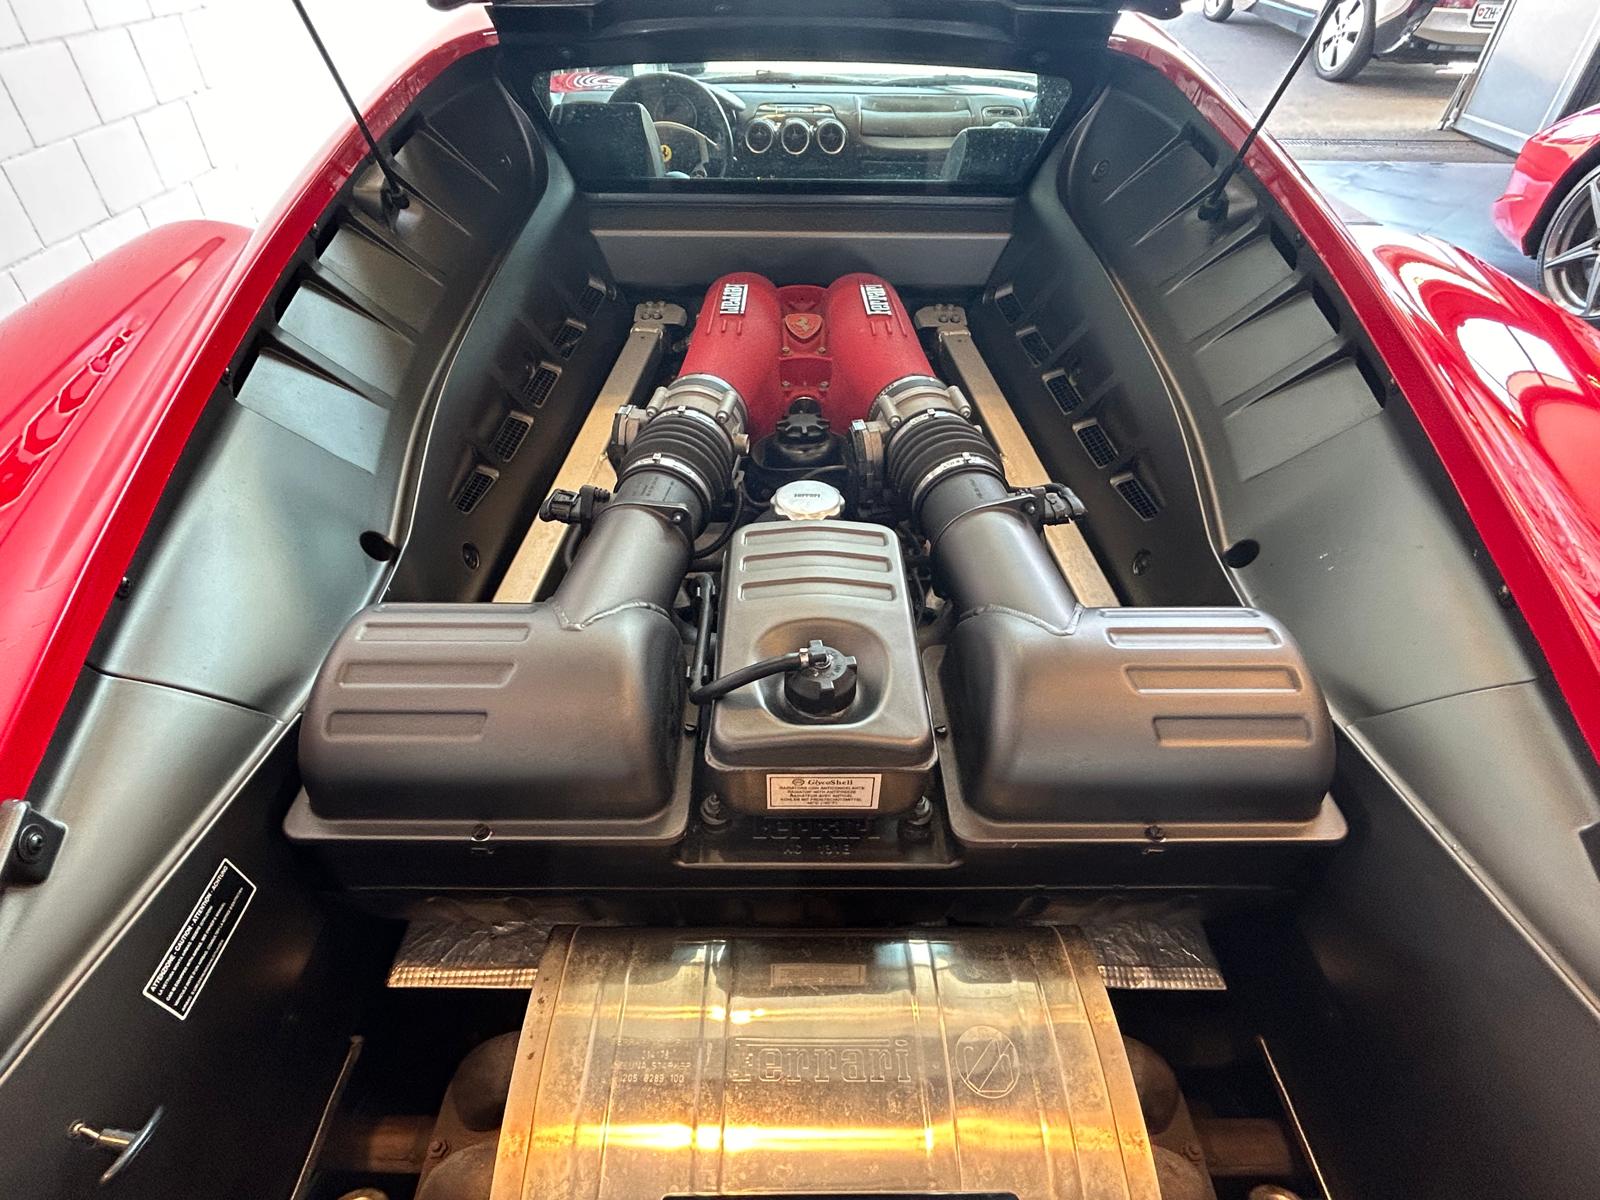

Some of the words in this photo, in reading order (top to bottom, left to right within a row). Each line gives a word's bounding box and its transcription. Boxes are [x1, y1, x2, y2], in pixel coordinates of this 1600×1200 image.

[720, 284, 748, 315] Ferrari
[860, 284, 893, 316] Ferrari
[151, 954, 175, 992] ATTENZIONE
[175, 926, 192, 951] CAUTION
[192, 893, 211, 923] ATTENTION
[212, 866, 228, 890] ACHTUNG
[731, 1036, 912, 1083] Ferrari
